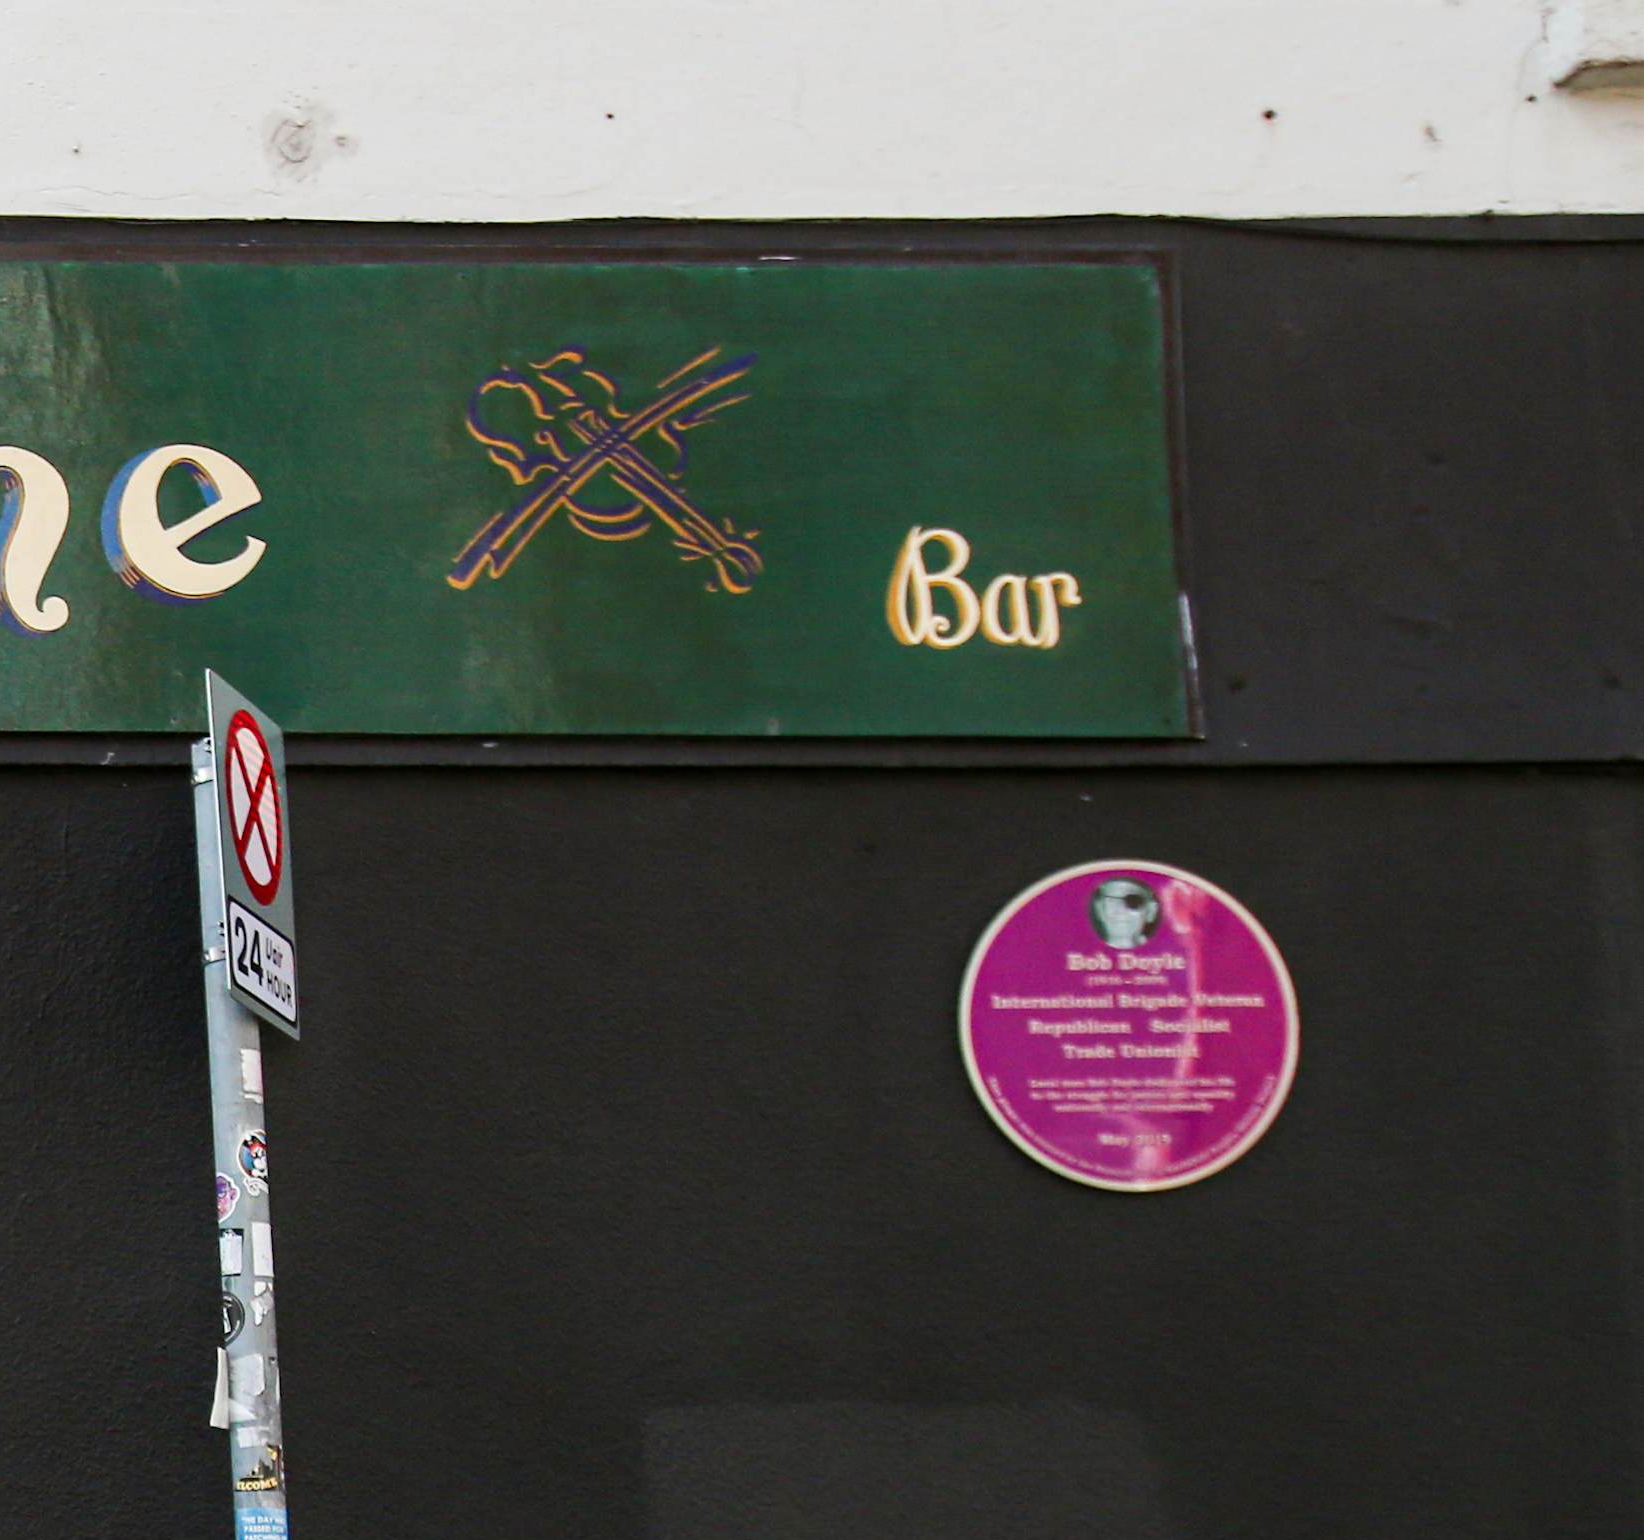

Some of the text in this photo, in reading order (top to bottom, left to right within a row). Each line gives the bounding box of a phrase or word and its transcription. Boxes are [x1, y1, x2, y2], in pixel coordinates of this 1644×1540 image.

[887, 526, 1082, 650] Bar
[235, 917, 263, 986] 24
[1067, 953, 1186, 974] Bob Doyle
[266, 968, 293, 1008] HOUR
[991, 994, 1114, 1009] International
[1028, 1019, 1131, 1038] Republican
[1062, 1044, 1115, 1058] Trade
